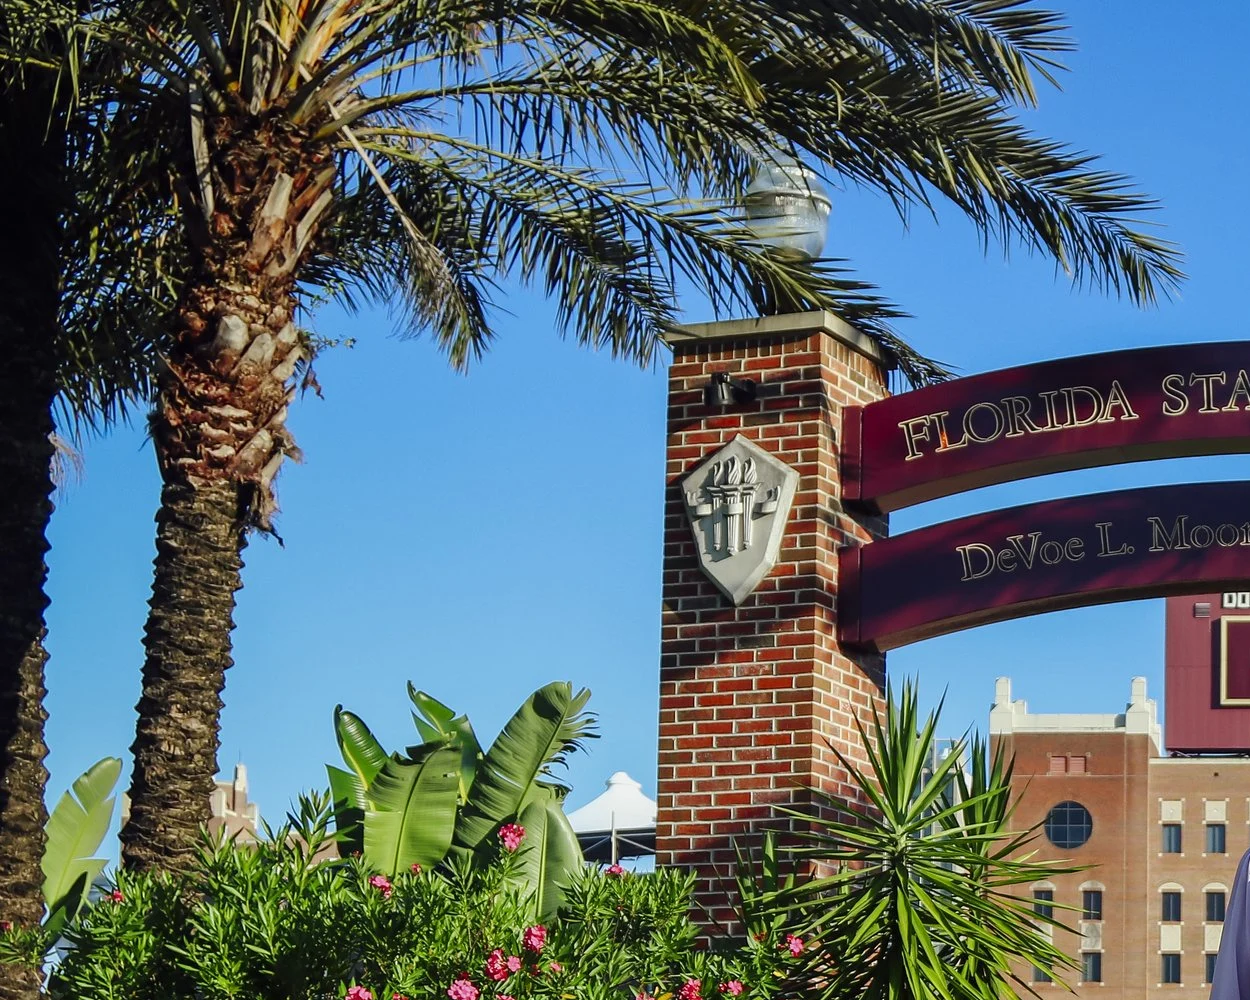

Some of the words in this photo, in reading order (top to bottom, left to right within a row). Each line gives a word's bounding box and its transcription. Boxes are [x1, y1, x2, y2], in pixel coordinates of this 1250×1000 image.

[899, 380, 1139, 461] FLORIDA
[956, 531, 1086, 582] DeVoe
[1096, 521, 1135, 558] L.
